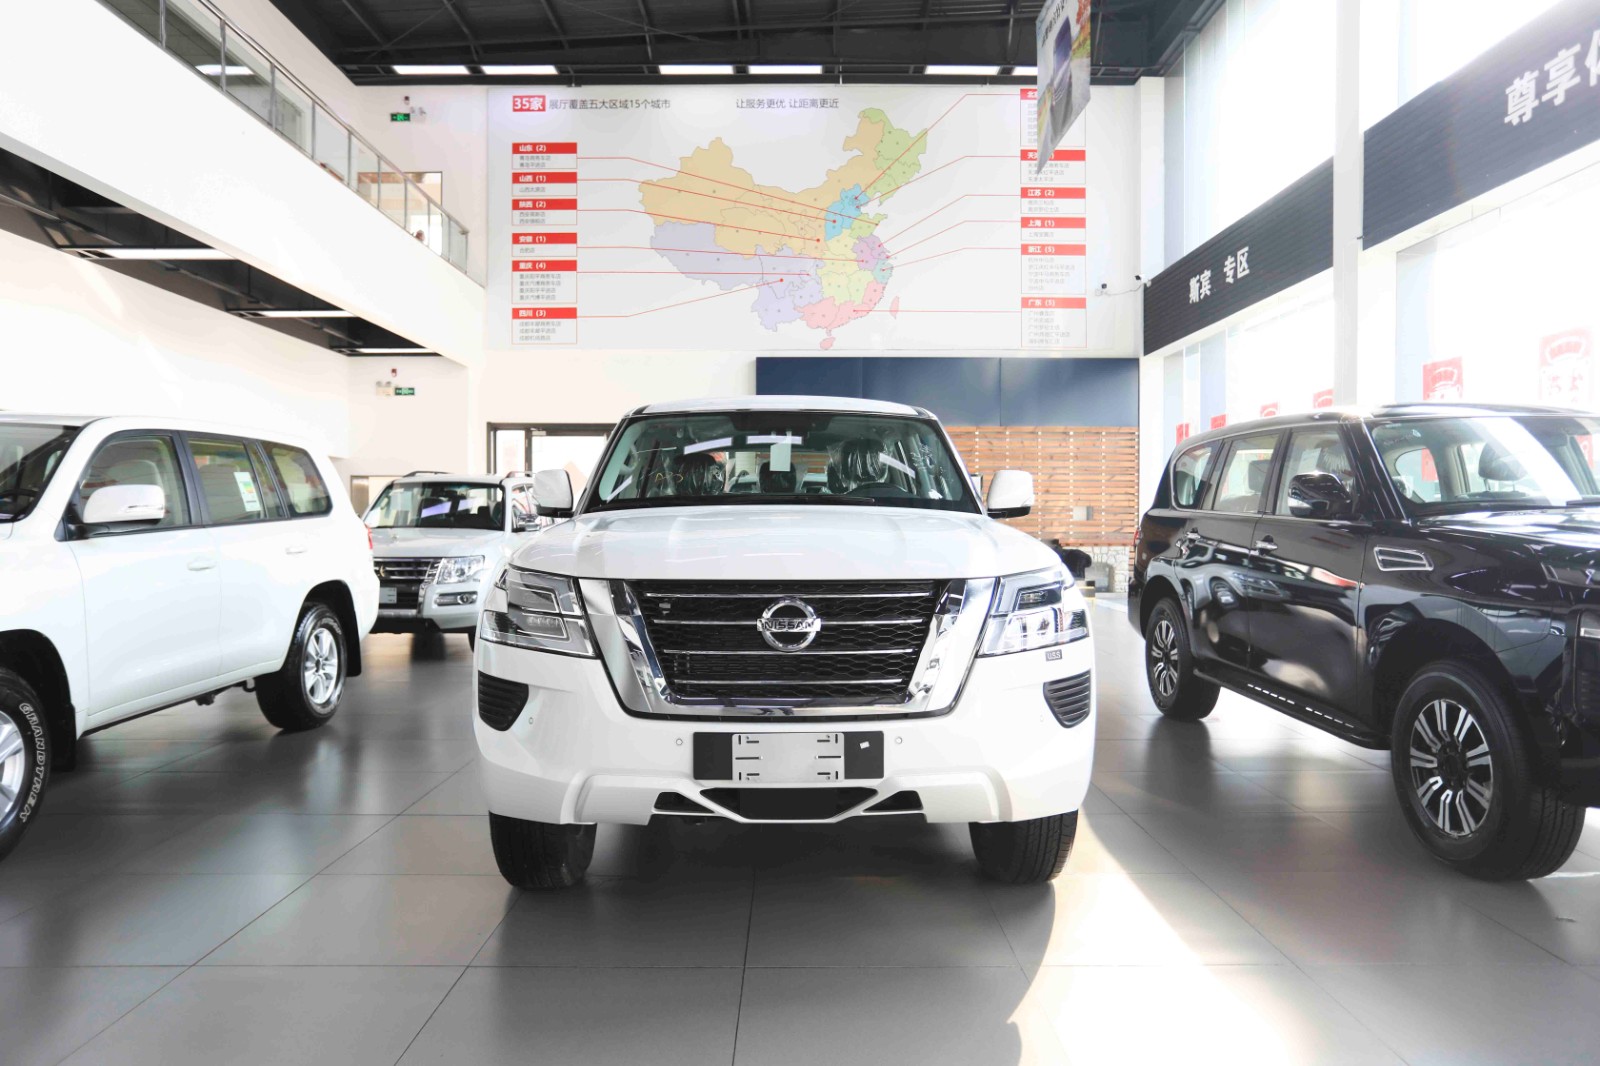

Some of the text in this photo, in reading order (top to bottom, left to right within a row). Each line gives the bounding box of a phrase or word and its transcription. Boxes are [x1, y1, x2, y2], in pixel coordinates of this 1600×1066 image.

[513, 97, 671, 110] 35家 展厅覆盖五大区域15个城市
[736, 98, 839, 109] 让服务更优 让距离更近
[519, 144, 547, 152] 山东 (2)
[1189, 246, 1250, 304] 斯宾 专区
[764, 621, 814, 630] NISSAN
[19, 702, 46, 823] GRANDTREK
